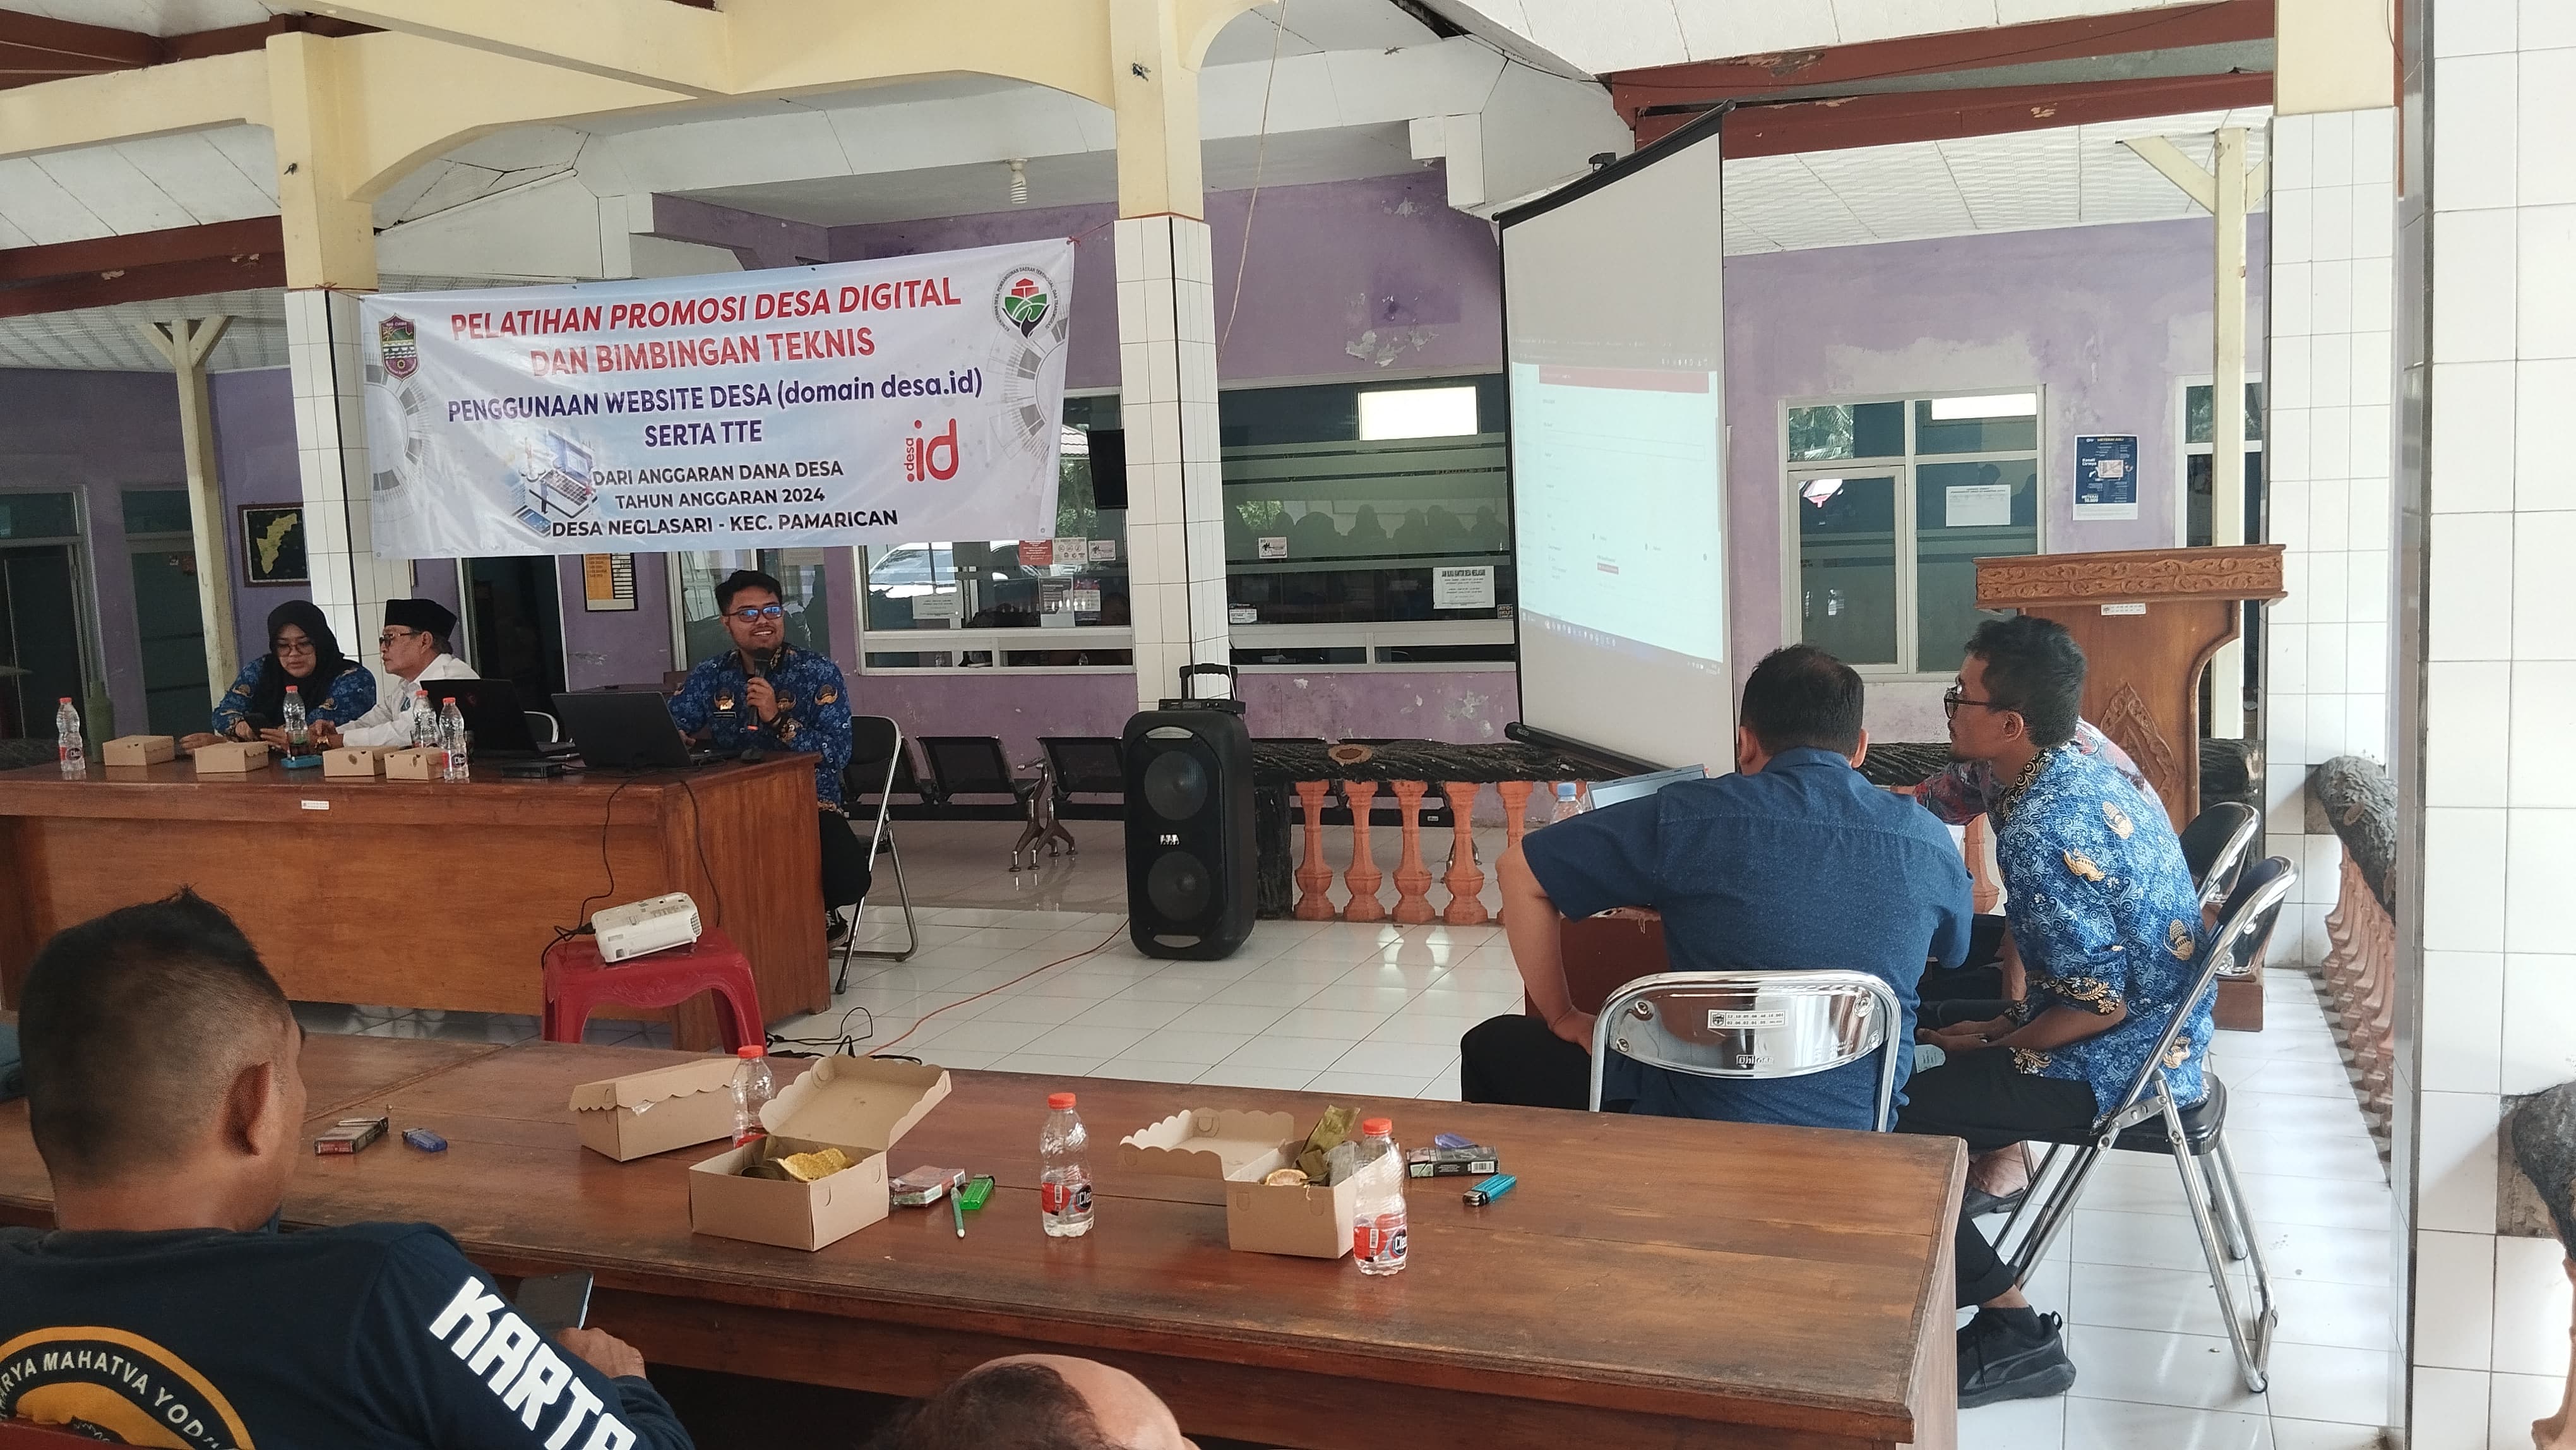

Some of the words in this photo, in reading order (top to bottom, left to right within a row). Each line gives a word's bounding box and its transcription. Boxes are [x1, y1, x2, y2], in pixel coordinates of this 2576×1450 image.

[451, 306, 602, 340] PELATIHAN
[610, 296, 746, 330] PROMOSI
[754, 289, 831, 320] DESA
[839, 277, 961, 313] DIGITAL
[530, 345, 588, 378] DAN
[596, 336, 760, 373] BIMBINGAN
[766, 327, 875, 362] TEKNIS
[449, 393, 598, 422] PENGGUNAAN
[604, 386, 703, 414] WEBSITE
[711, 383, 771, 407] DESA
[778, 375, 874, 409] (domain
[881, 367, 982, 399] desa.id)
[645, 424, 716, 447] SERTA
[720, 420, 762, 443] TTE
[593, 469, 633, 486] DARI
[638, 465, 734, 484] ANGGARAN
[740, 462, 790, 480] DANA
[796, 460, 844, 477] DESA
[615, 493, 673, 509] TAHUN
[678, 490, 778, 507] ANGGARAN
[782, 488, 825, 503] 2024
[552, 520, 603, 537] DESA
[608, 517, 713, 536] NEGLASARI
[730, 515, 773, 532] KEC.
[778, 510, 898, 529] PAMARICAN
[44, 1350, 148, 1395] MAHATVA
